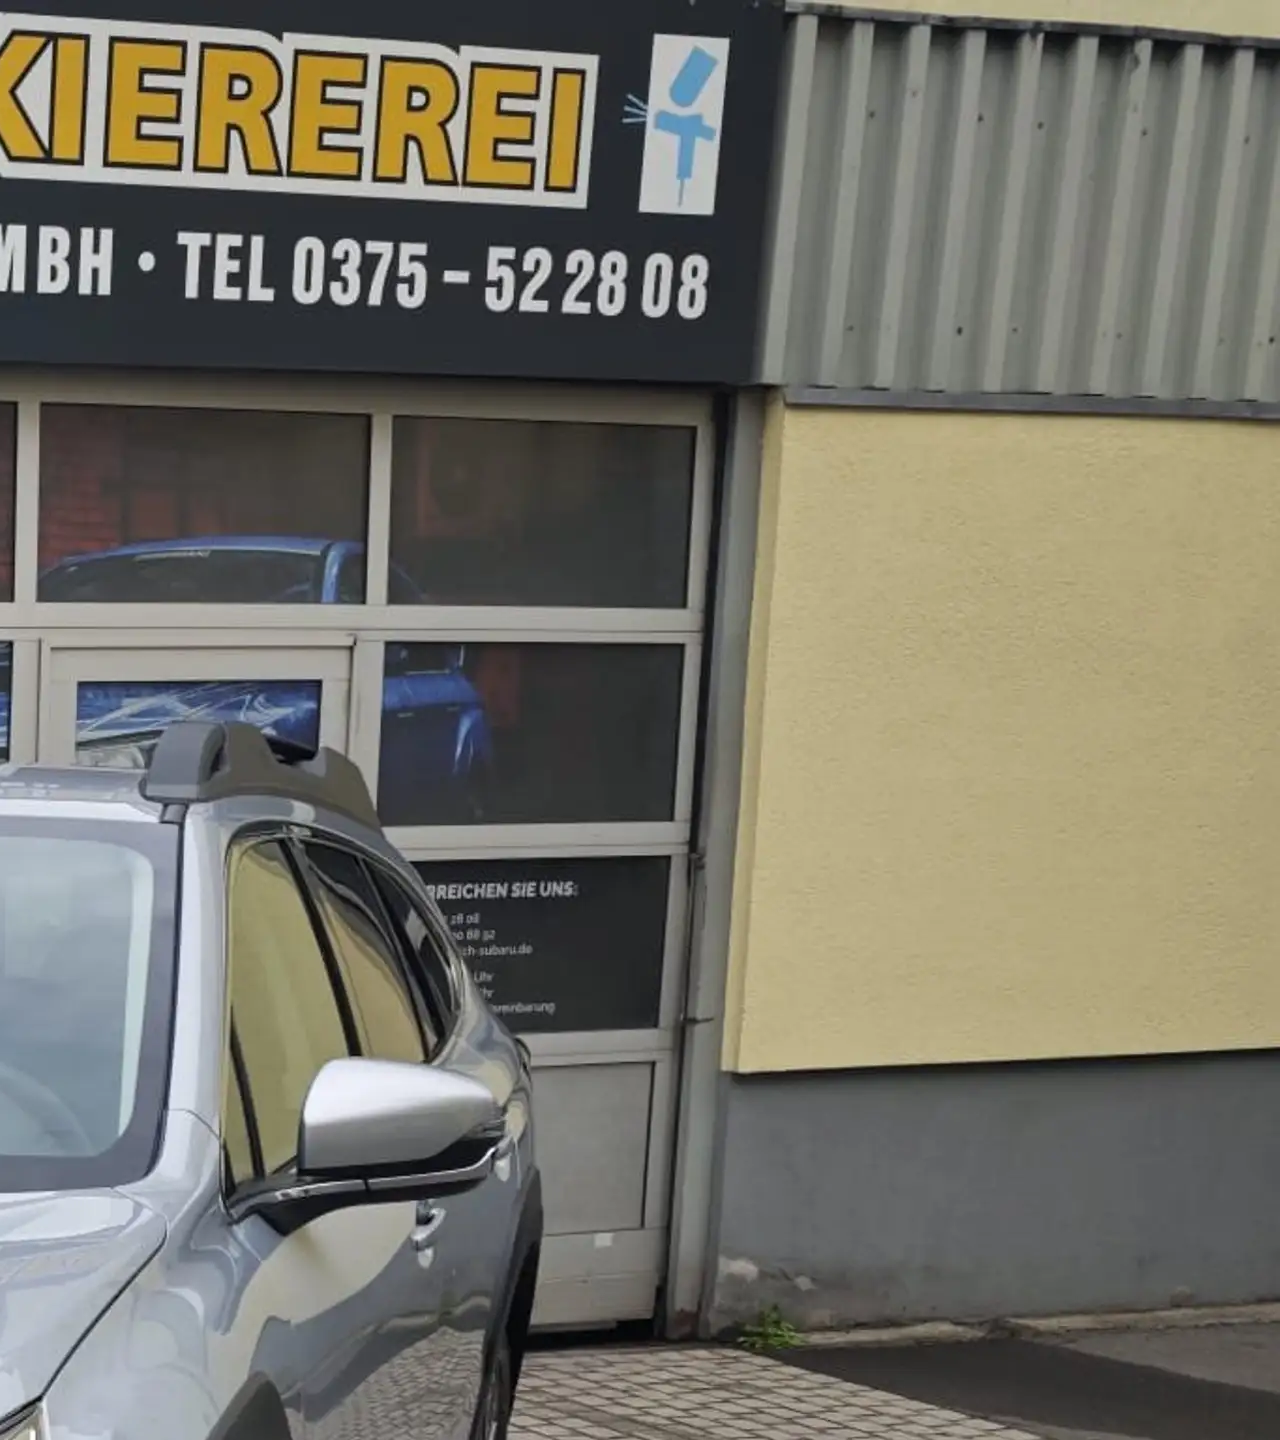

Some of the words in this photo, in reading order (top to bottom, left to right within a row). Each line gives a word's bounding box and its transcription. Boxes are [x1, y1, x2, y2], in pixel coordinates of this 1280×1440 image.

[176, 231, 275, 302] TEL
[291, 236, 428, 309] 0375
[511, 882, 537, 898] SIE
